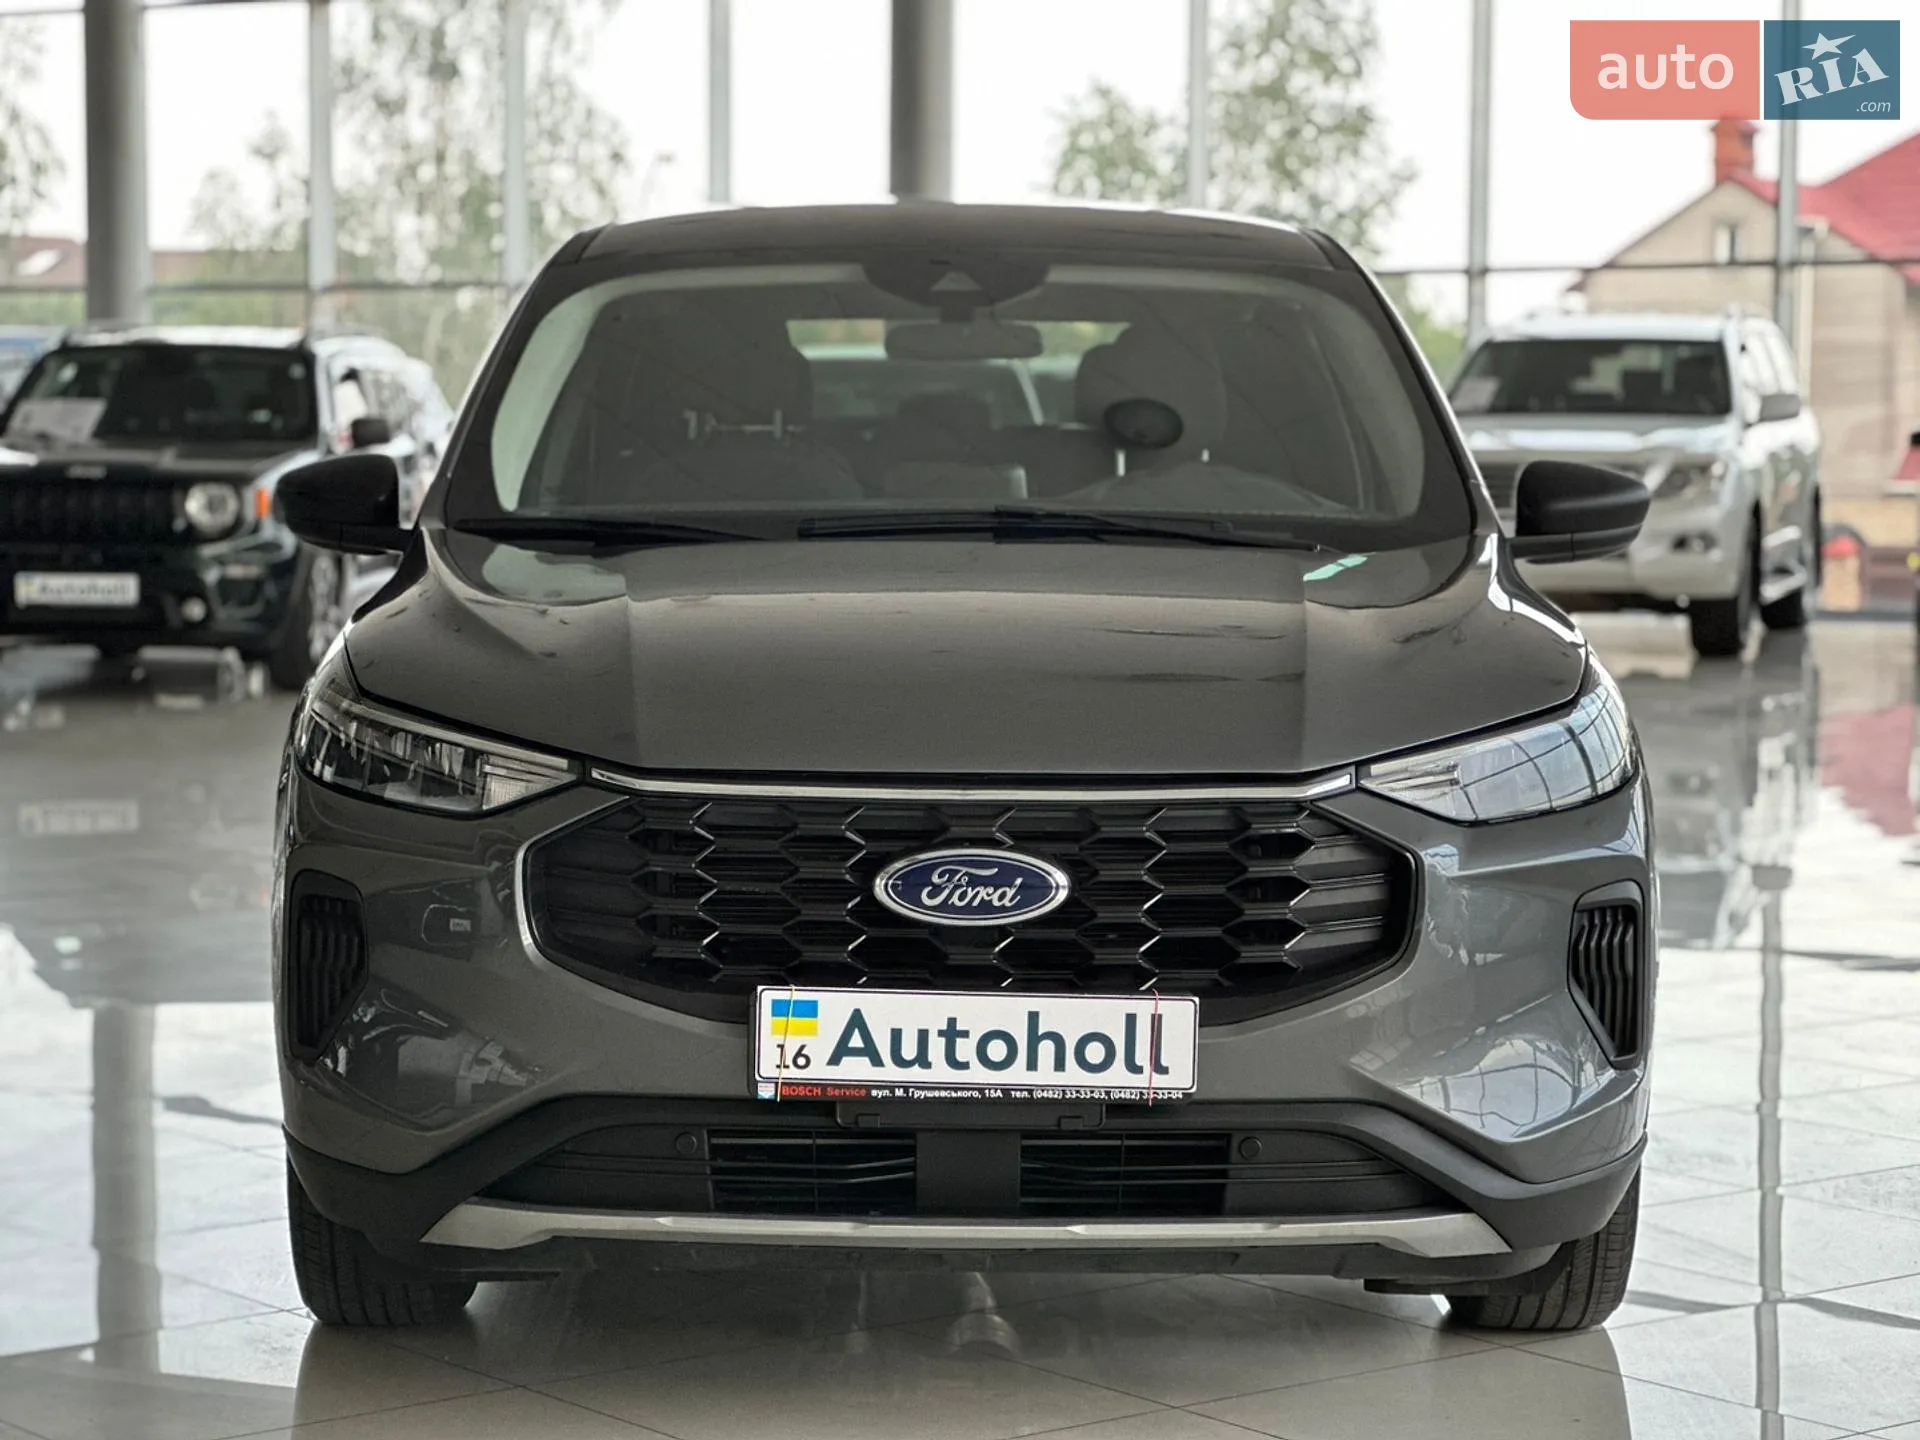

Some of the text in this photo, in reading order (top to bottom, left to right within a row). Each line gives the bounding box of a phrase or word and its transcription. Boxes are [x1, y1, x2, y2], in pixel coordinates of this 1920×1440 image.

[921, 865, 1023, 907] Ford
[775, 1044, 811, 1070] 16
[826, 1007, 1169, 1075] Autoholl
[781, 1085, 822, 1096] BOSCH
[826, 1086, 867, 1097] Service
[871, 1088, 893, 1099] вул.
[895, 1087, 907, 1097] М.
[909, 1088, 982, 1099] Грушевського,
[1011, 1090, 1031, 1098] тел.
[1033, 1089, 1063, 1099] (0482)
[1110, 1090, 1139, 1100] (0482)
